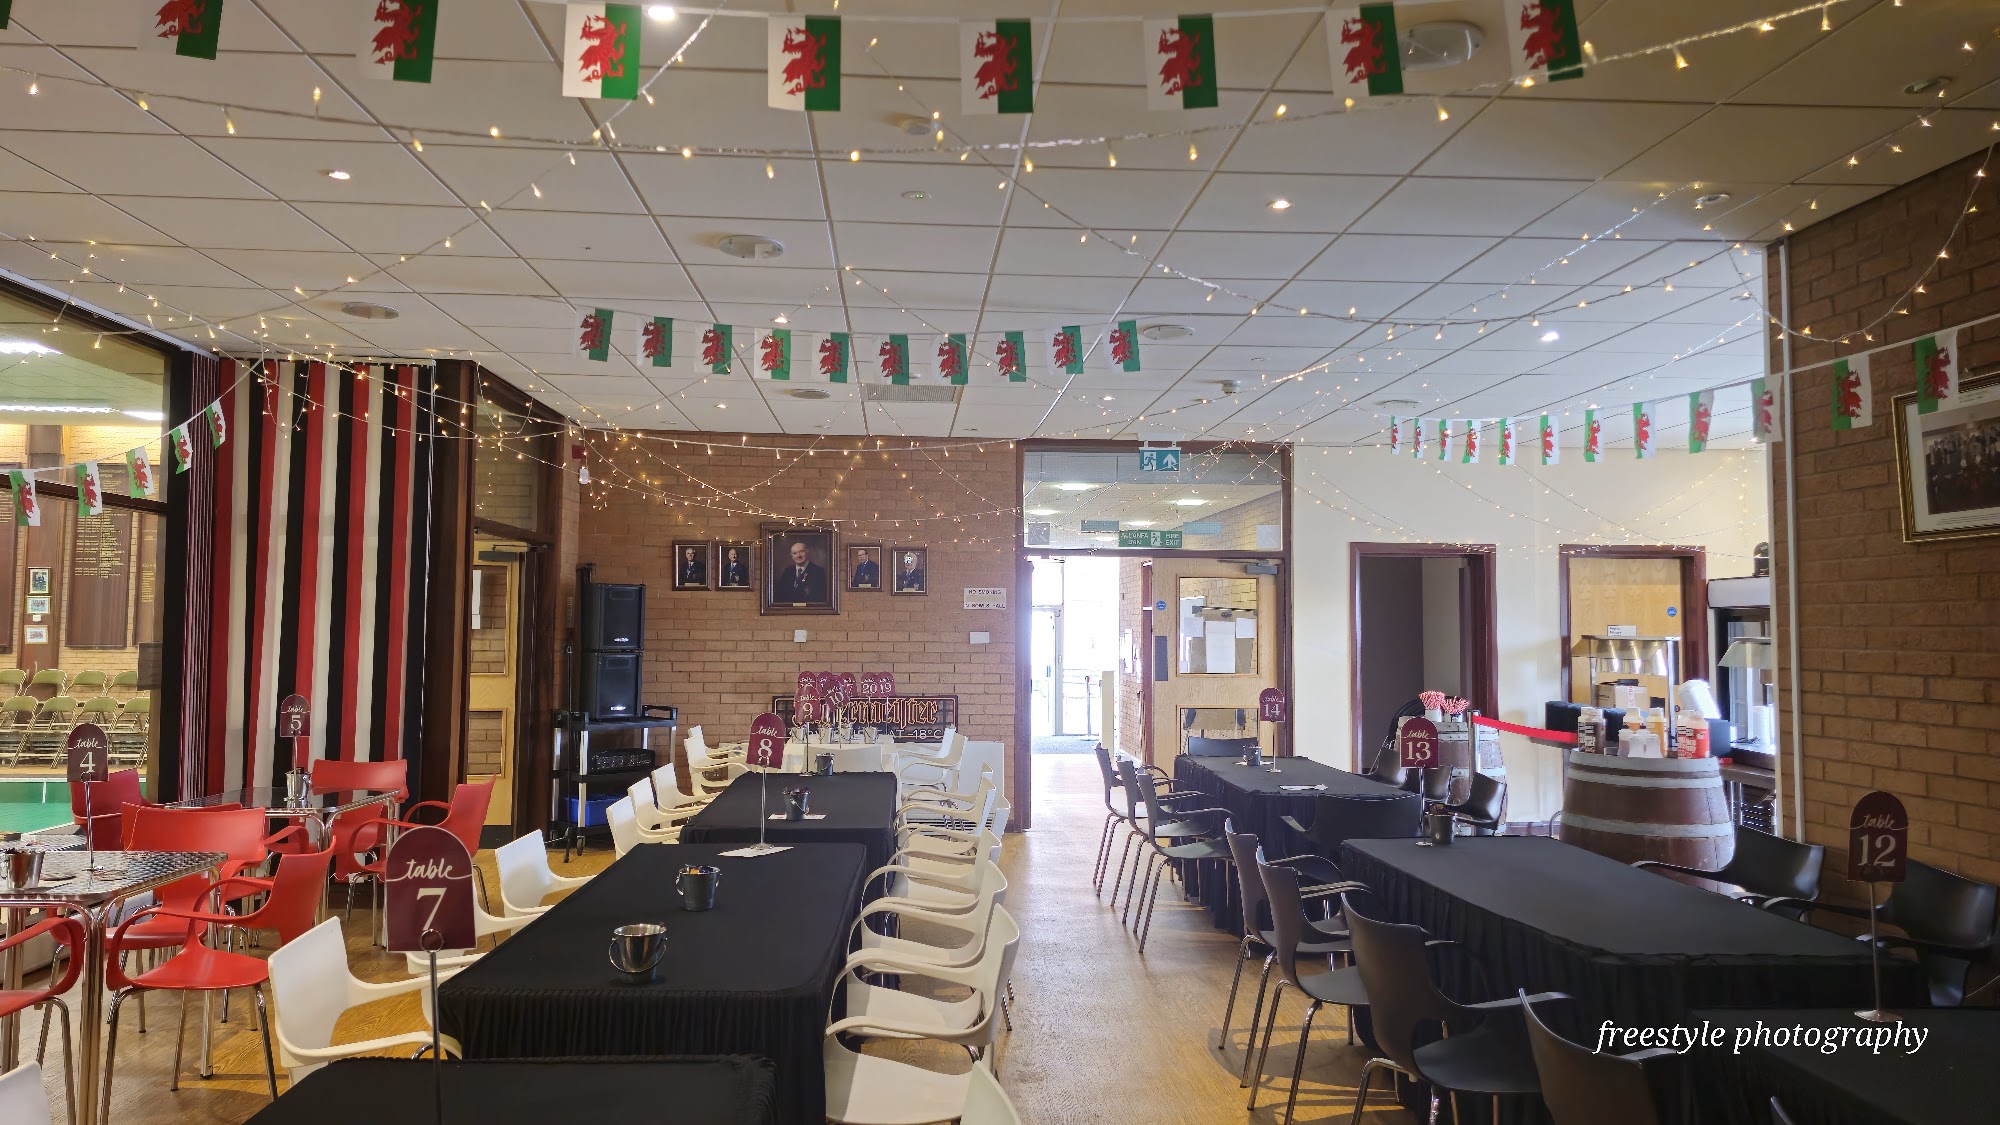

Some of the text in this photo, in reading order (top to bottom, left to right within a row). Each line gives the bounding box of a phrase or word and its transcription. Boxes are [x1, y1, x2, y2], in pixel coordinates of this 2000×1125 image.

[862, 683, 878, 694] 20
[879, 682, 892, 694] 19
[829, 691, 844, 705] 10
[803, 702, 813, 717] 9
[1264, 703, 1281, 717] 14
[290, 714, 302, 731] 5
[757, 725, 778, 738] table
[1407, 729, 1429, 739] table
[76, 737, 99, 749] table
[757, 738, 773, 758] 8
[1405, 741, 1431, 761] 13
[79, 751, 96, 773] 4
[1862, 813, 1895, 829] table
[1858, 834, 1897, 867] 12
[406, 858, 453, 880] table
[416, 887, 447, 931] 7
